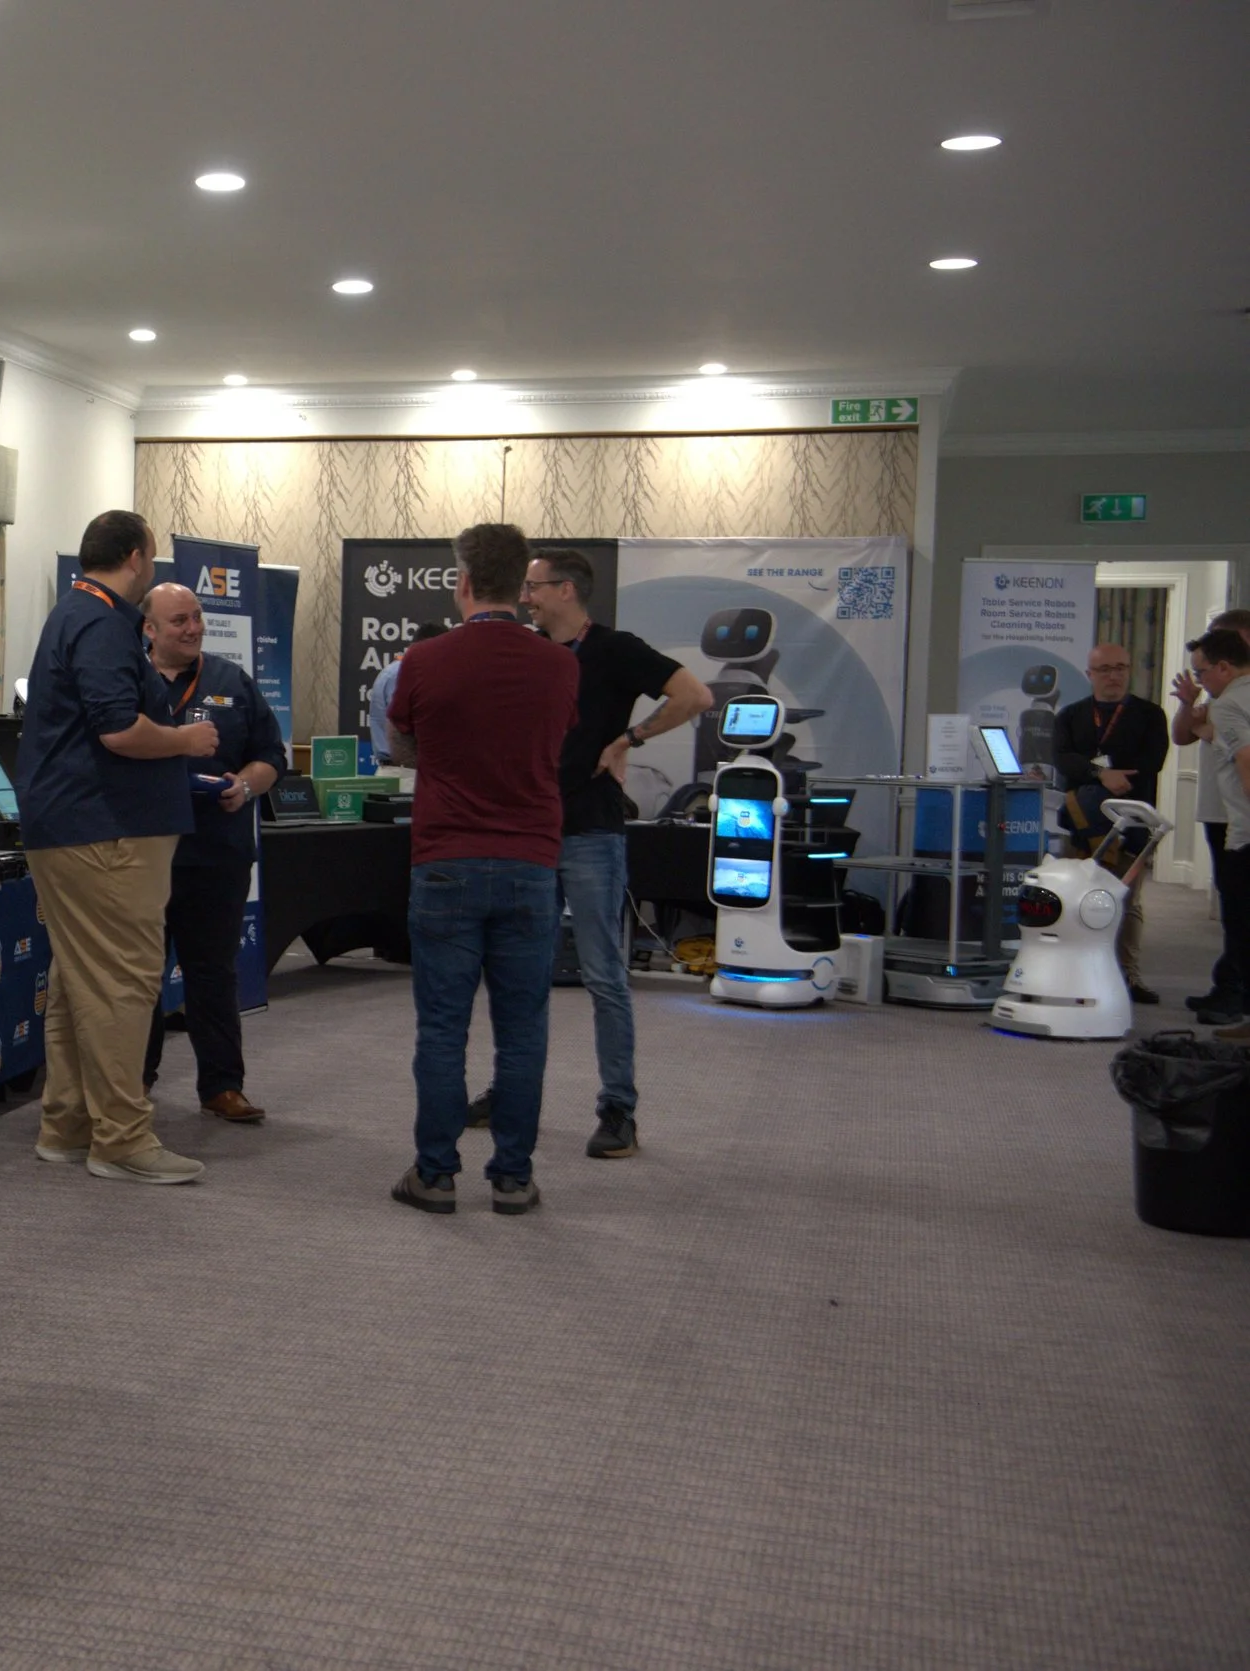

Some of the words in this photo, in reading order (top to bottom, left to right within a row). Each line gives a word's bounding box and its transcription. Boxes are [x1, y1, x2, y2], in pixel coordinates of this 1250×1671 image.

[838, 401, 861, 412] Fire
[838, 412, 861, 423] exit
[747, 568, 764, 577] SEE
[767, 568, 784, 577] THE
[787, 568, 824, 577] RANGE
[195, 564, 241, 598] ASE
[1012, 577, 1064, 589] KEENON
[1008, 598, 1042, 607] Service
[1044, 598, 1076, 608] Robots
[980, 608, 1006, 617] Room
[1008, 609, 1042, 618] Service
[1044, 609, 1076, 619] Robots
[990, 620, 1032, 630] Cleaning
[1035, 621, 1066, 630] Robots
[202, 695, 234, 706] ASE
[13, 936, 32, 955] ASE
